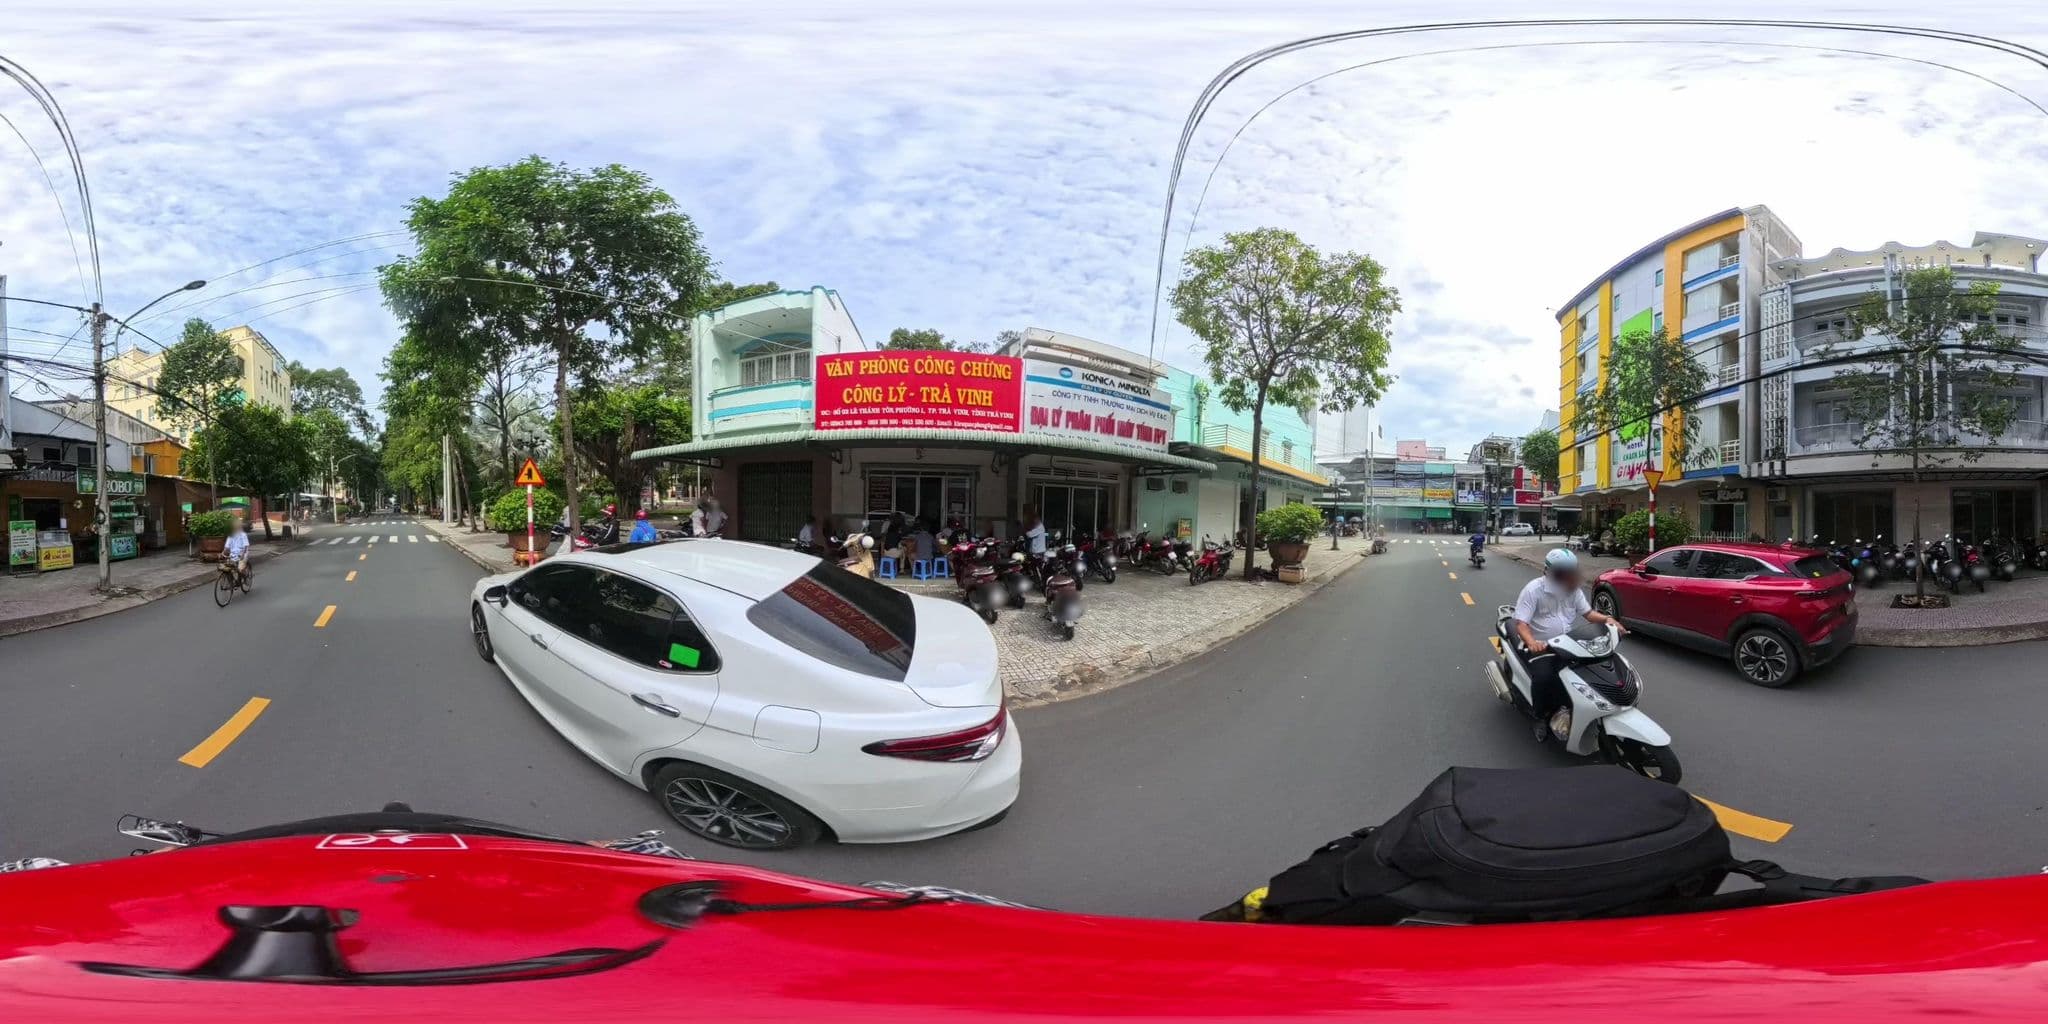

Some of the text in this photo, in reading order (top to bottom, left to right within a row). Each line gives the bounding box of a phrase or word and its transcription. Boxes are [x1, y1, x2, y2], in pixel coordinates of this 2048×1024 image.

[825, 355, 1012, 380] VĂN PHÒNG CÔNG CHỨNG
[842, 384, 883, 404] CÔNG
[887, 382, 908, 403] LÝ
[919, 383, 952, 404] TRÀ
[956, 388, 993, 407] VINH
[1051, 390, 1071, 400] CÔNG
[1073, 393, 1082, 401] TY
[1082, 372, 1151, 397] KONICA MINOLTA
[1051, 406, 1063, 428] LÝ
[1065, 409, 1091, 431] PHÂN
